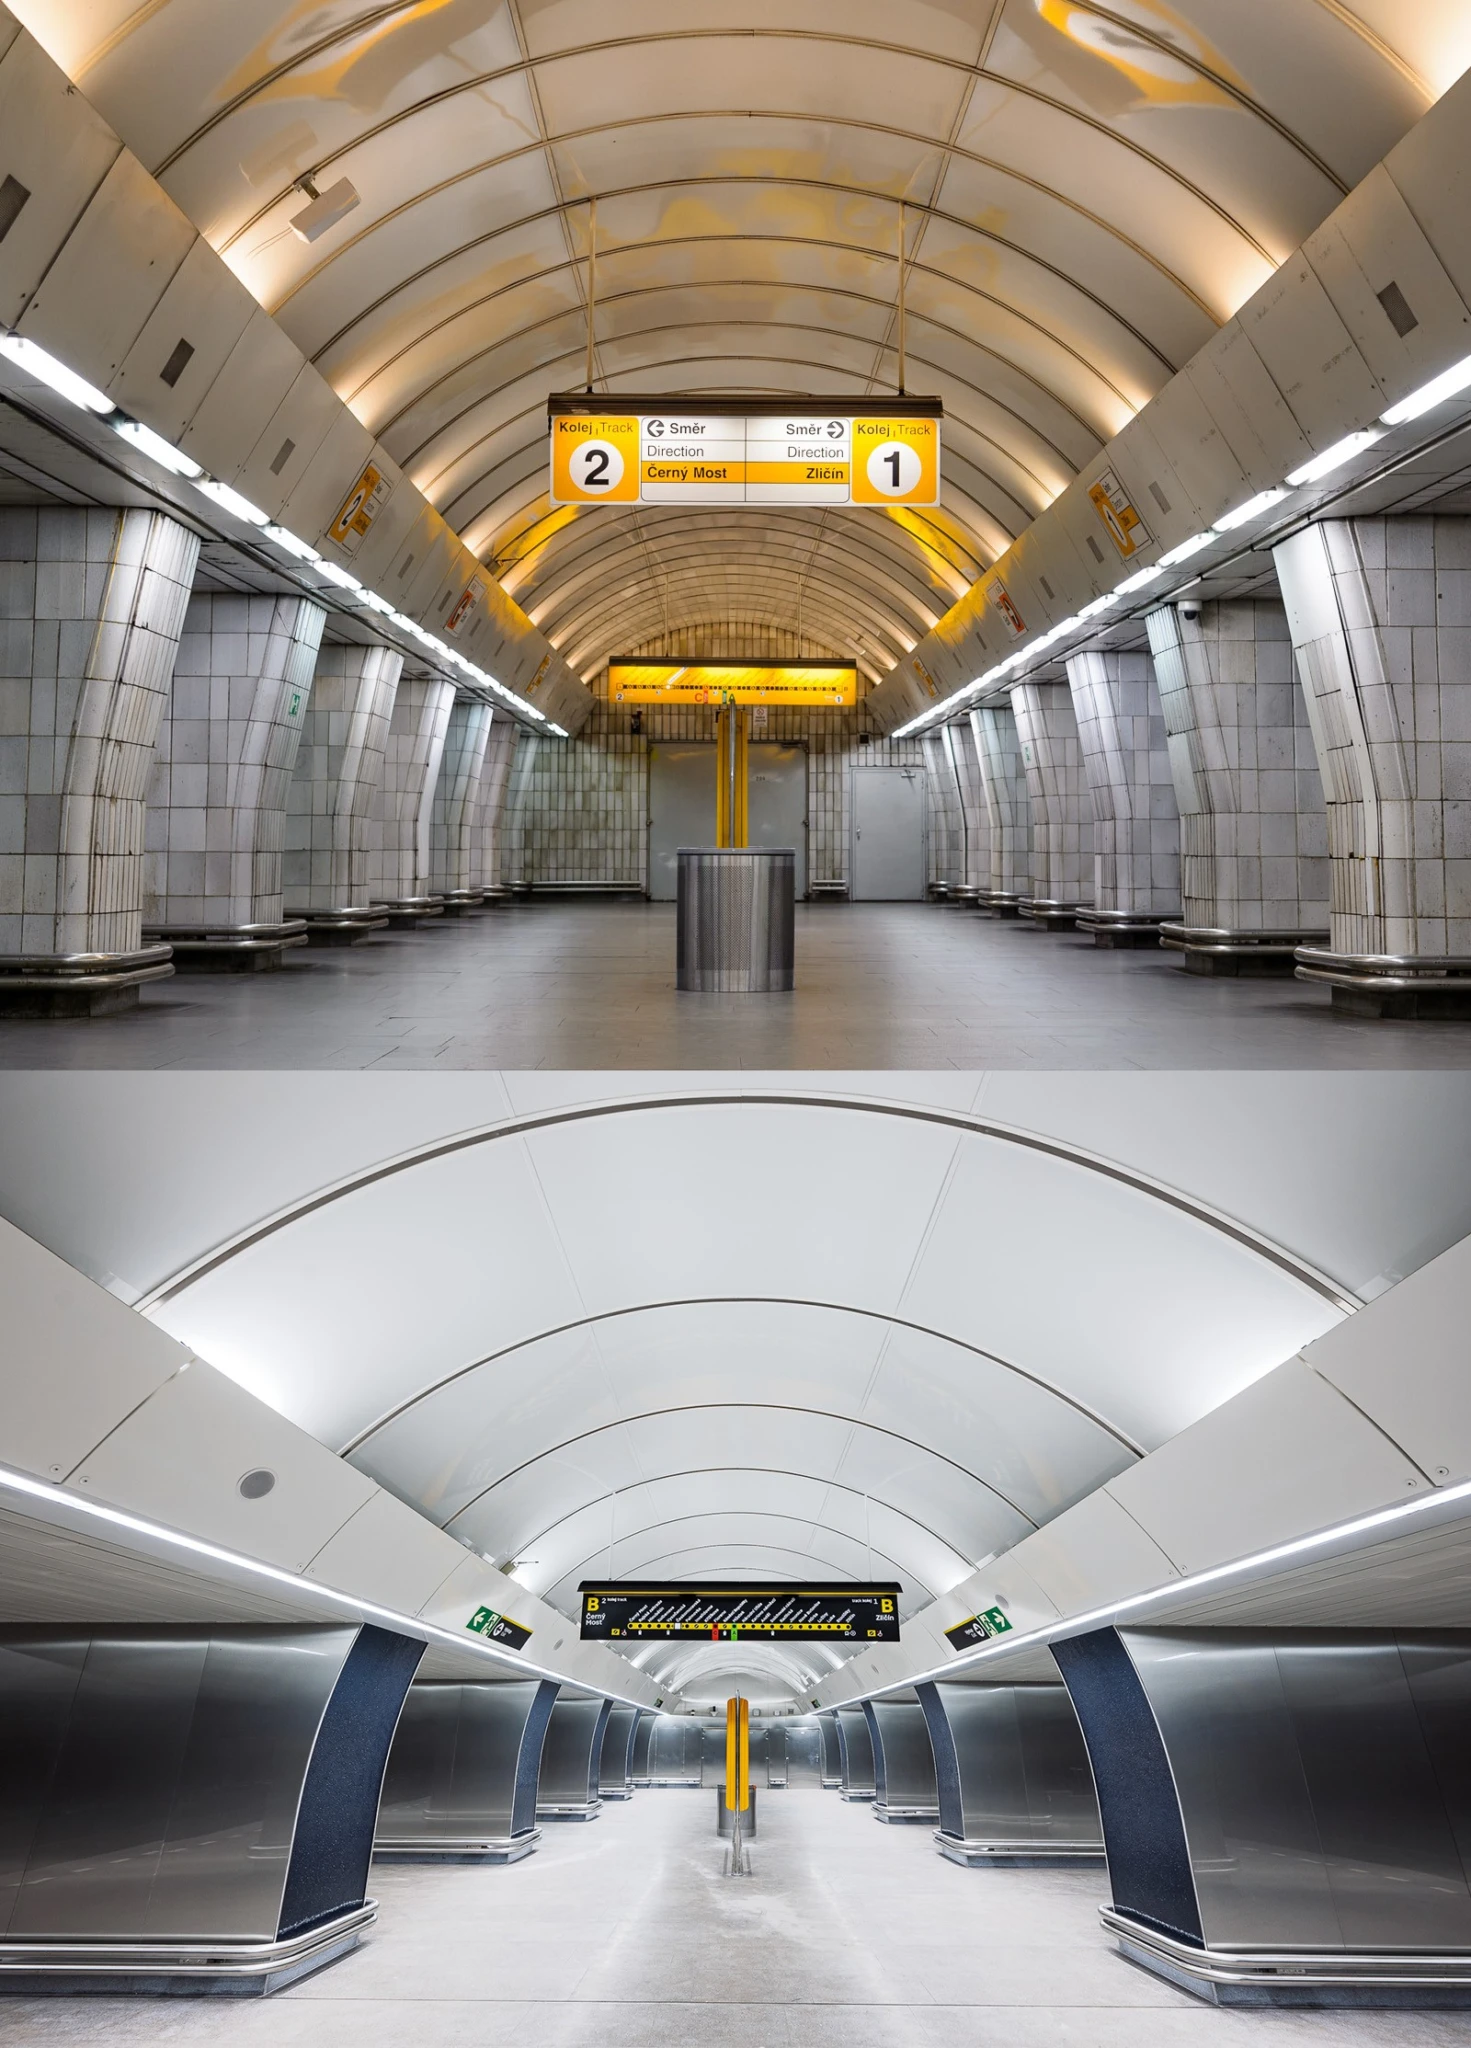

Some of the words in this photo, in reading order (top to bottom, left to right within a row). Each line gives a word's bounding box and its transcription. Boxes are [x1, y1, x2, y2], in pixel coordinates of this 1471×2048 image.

[560, 422, 592, 434] Kolej
[600, 422, 634, 432] Track
[670, 422, 706, 434] Směr
[786, 423, 822, 435] Směr
[858, 424, 890, 437] Kolej
[897, 424, 930, 435] Track
[647, 445, 704, 457] Direction
[787, 446, 844, 458] Direction
[584, 449, 610, 486] 2
[647, 464, 688, 480] Černý
[693, 467, 727, 478] Most
[806, 467, 844, 479] Zličín
[884, 451, 900, 487] 1
[341, 494, 362, 526] 2
[694, 692, 702, 702] C
[588, 1597, 599, 1611] B
[881, 1599, 894, 1613] B
[586, 1612, 606, 1620] Černý
